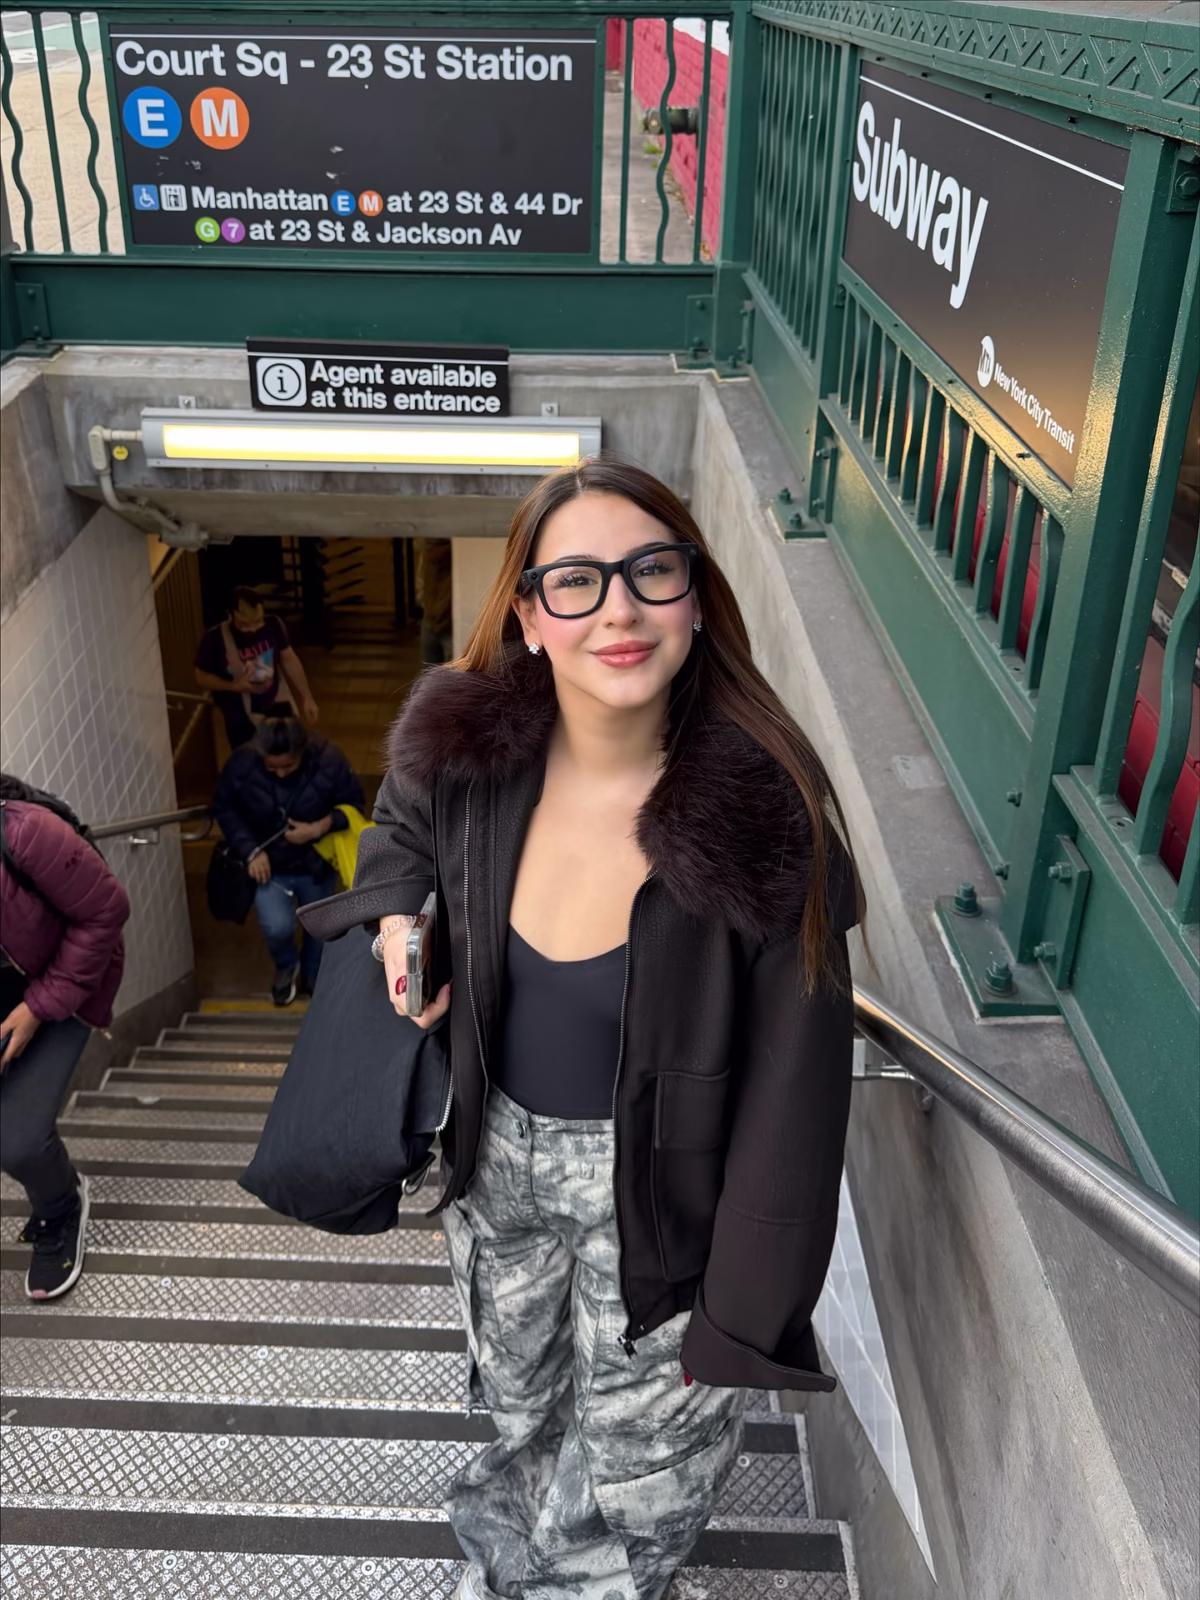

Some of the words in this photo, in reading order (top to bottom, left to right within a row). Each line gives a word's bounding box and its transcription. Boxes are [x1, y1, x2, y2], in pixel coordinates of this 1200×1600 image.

[115, 40, 227, 77] Court
[236, 41, 289, 85] Sq
[299, 58, 315, 69] -
[326, 43, 374, 79] 23
[383, 43, 426, 80] St
[436, 42, 574, 81] Station
[138, 99, 169, 137] E
[201, 98, 240, 138] M
[191, 186, 328, 212] Manhattan
[337, 194, 350, 212] E
[362, 195, 380, 212] M
[386, 191, 413, 213] at
[418, 190, 450, 214] 23
[455, 190, 484, 214] St
[489, 191, 509, 215] &
[514, 192, 546, 215] 44
[552, 192, 583, 216] Dr
[853, 101, 989, 309] Subway
[200, 221, 215, 238] G
[227, 223, 240, 239] 7
[249, 219, 276, 241] at
[280, 219, 312, 242] 23
[317, 219, 346, 243] St
[351, 220, 371, 243] &
[375, 220, 483, 245] Jackson
[488, 223, 522, 246] Av
[310, 360, 385, 388] Agent
[390, 364, 497, 388] available
[310, 387, 337, 408] at
[342, 386, 388, 410] this
[393, 390, 501, 413] entrance
[994, 363, 1011, 392] New
[1011, 377, 1028, 409] York
[1027, 394, 1044, 428] City
[1044, 408, 1075, 454] Transit
